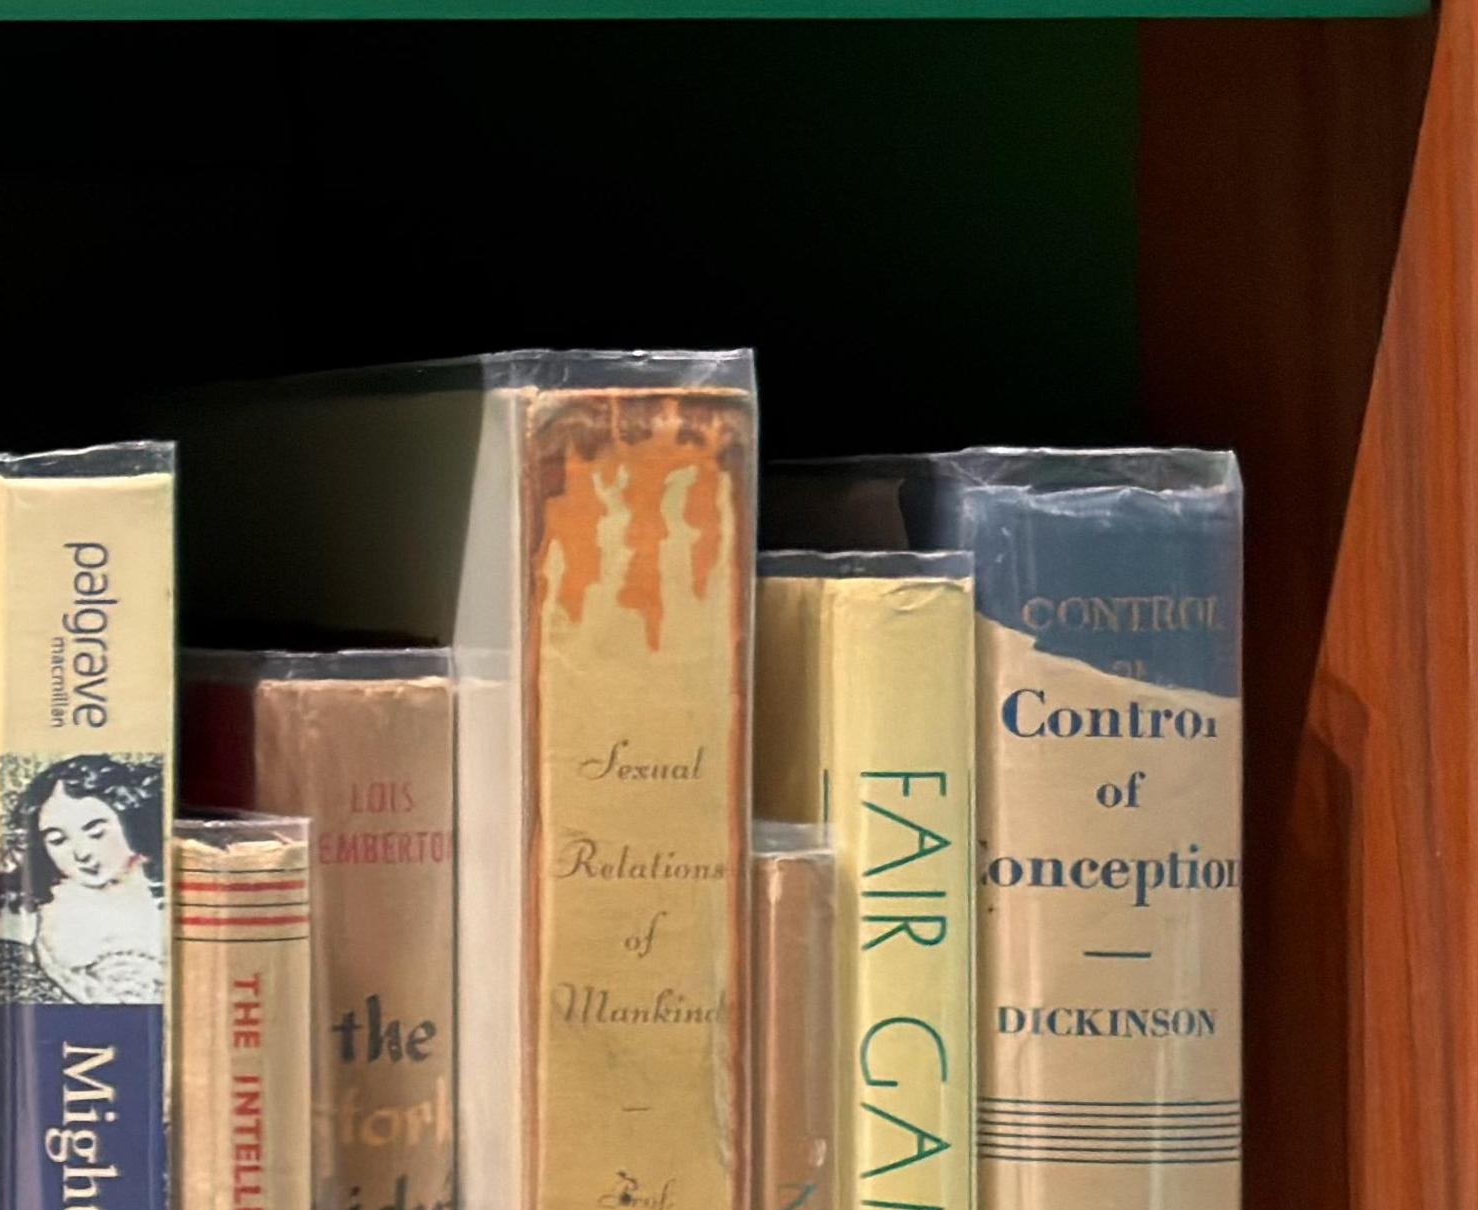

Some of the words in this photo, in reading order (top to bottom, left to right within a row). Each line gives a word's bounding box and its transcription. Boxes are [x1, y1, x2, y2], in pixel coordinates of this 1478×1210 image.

[63, 542, 118, 728] palgrave
[351, 782, 416, 814] LOIS
[1096, 771, 1146, 809] of
[861, 770, 952, 951] FAIR
[233, 973, 260, 1048] THE
[997, 1005, 1216, 1039] DICKINSON
